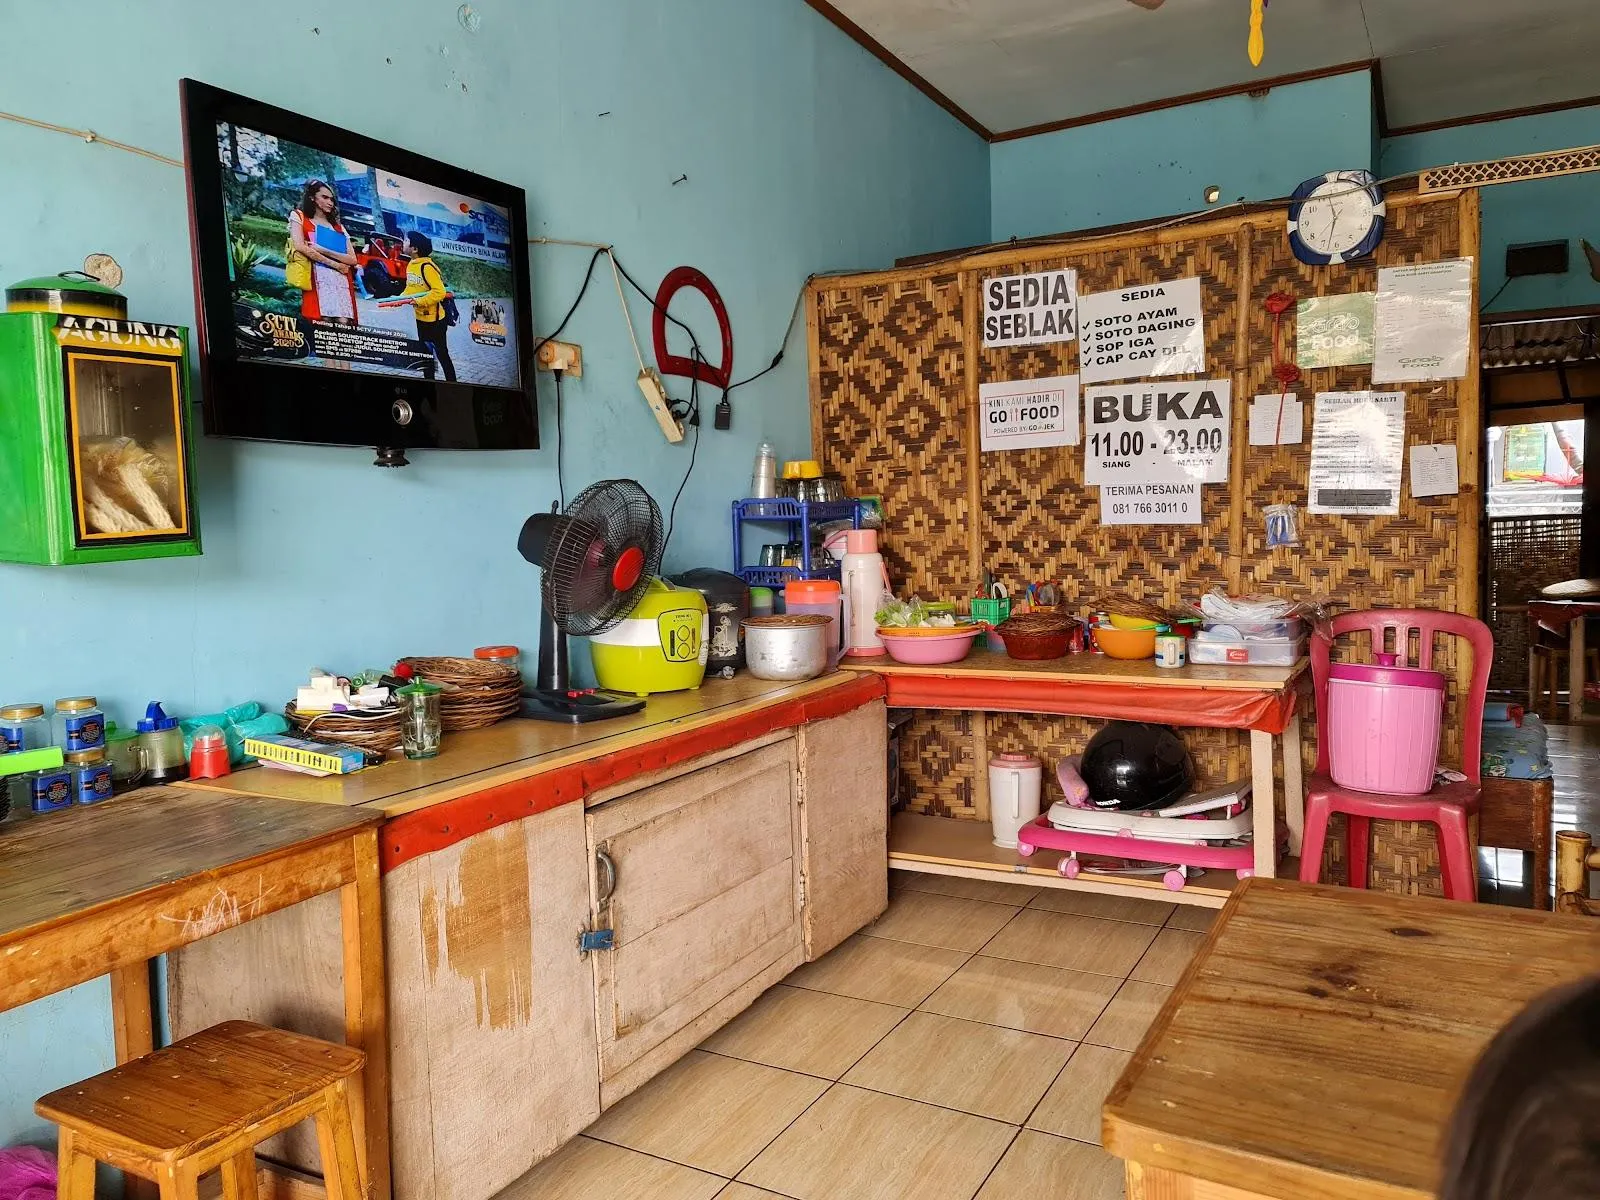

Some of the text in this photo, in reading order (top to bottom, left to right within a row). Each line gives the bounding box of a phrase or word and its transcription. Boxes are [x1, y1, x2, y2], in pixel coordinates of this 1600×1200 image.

[441, 241, 477, 255] UNIVERSITAS
[989, 274, 1070, 312] SEDIA
[1121, 287, 1165, 302] SEDIA
[259, 313, 297, 334] SCTV
[985, 308, 1074, 341] SEBLAK
[1094, 307, 1178, 328] SOTO AYAM
[58, 316, 182, 350] AGUNG
[1095, 318, 1196, 341] SOTO DAGING
[273, 338, 295, 348] 2020
[314, 334, 339, 342] PALING
[338, 332, 379, 343] SOUNDTRACK
[379, 338, 408, 347] SINETRON
[1096, 337, 1155, 353] SOP IGA
[1096, 353, 1124, 366] CAP
[1129, 348, 1157, 360] CAY
[1398, 355, 1445, 364] Grab
[988, 393, 1060, 408] KINI KAMI HADIR DI
[1093, 390, 1224, 424] BUKA
[990, 405, 1060, 424] GO FOOD
[994, 426, 1018, 434] POWERED
[1091, 430, 1144, 457] 11.00
[1163, 427, 1223, 455] 23.00
[1102, 461, 1131, 469] SIANG
[1105, 484, 1195, 496] TERIMA PESANAN
[1112, 502, 1188, 514] 081 766 3011 0
